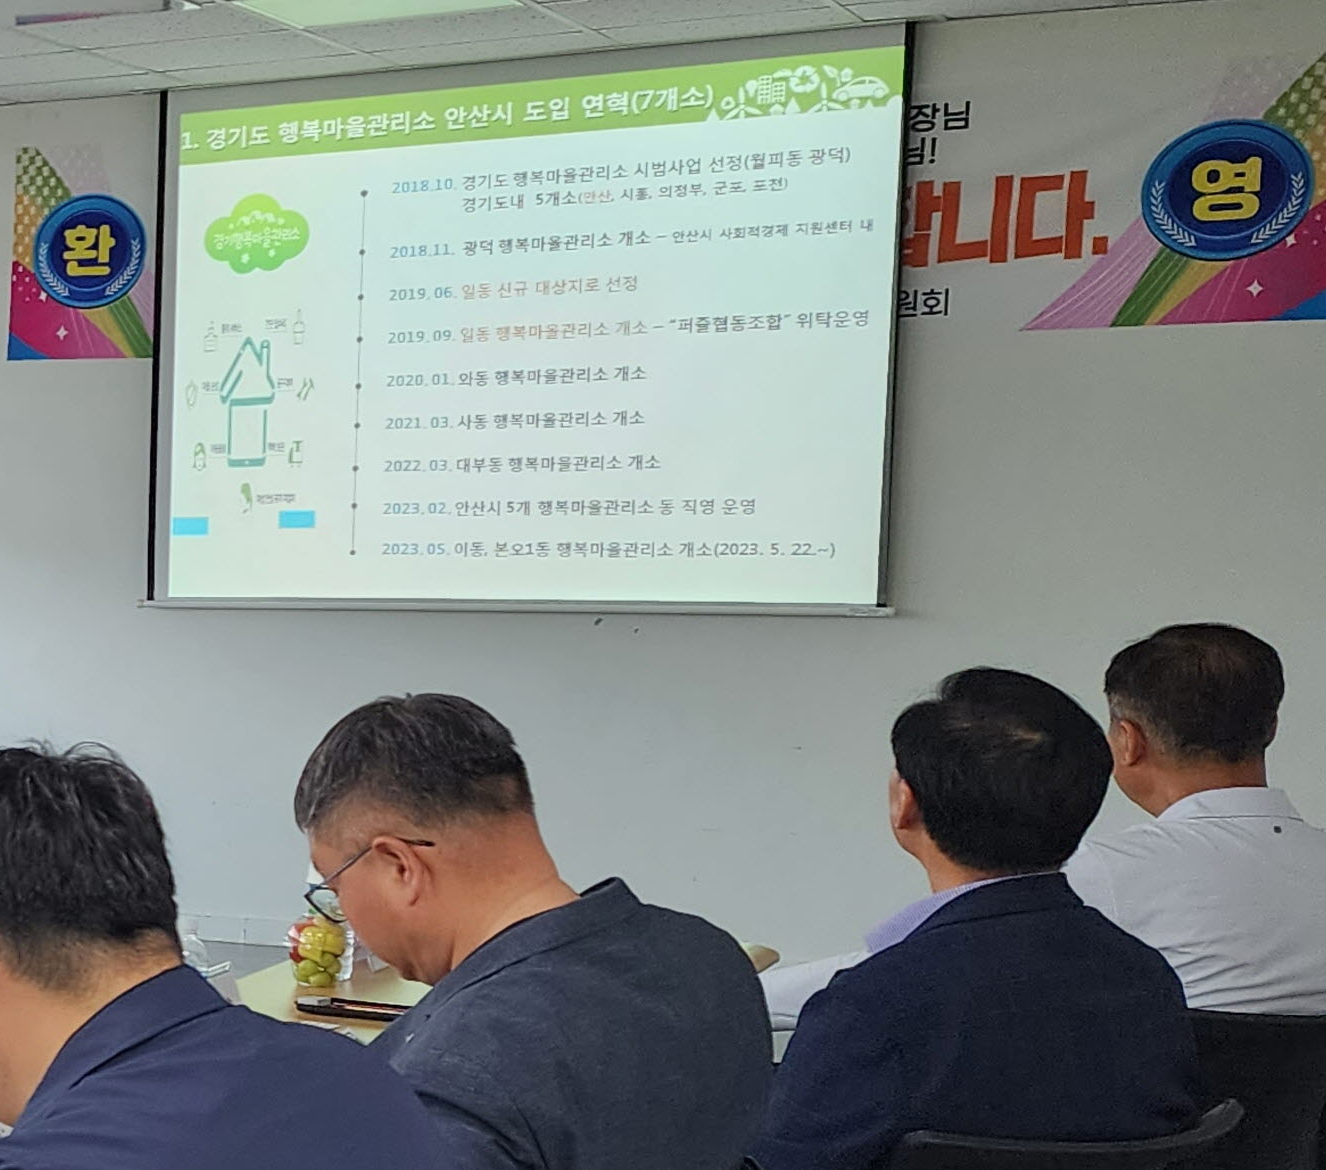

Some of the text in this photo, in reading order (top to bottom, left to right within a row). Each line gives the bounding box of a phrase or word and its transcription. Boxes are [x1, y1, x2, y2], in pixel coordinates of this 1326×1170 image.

[181, 84, 714, 151] 1. 경기도 행복마을관리소 안산시 도입 연혁(7개소)
[461, 174, 509, 191] 경기도
[513, 164, 628, 187] 행복마을관리소
[634, 158, 701, 178] 시범사업
[1191, 157, 1263, 222] 영
[462, 194, 524, 213] 경기도내
[63, 225, 116, 276] 환
[462, 239, 494, 257] 광덕
[498, 232, 613, 255] 행복마을관리소
[617, 229, 650, 246] 개소
[672, 228, 712, 244] 안산시
[720, 223, 789, 240] 사회적경제
[795, 219, 853, 236] 지원센터
[860, 218, 874, 232] 내
[461, 283, 492, 301] 일동
[497, 281, 529, 299] 신규
[535, 277, 600, 297] 대상지로
[605, 275, 638, 293] 선정
[460, 326, 491, 344] 일동
[495, 321, 610, 342] 행복마을관리소
[616, 320, 648, 337] 개소
[795, 310, 870, 330] 위탁운영
[458, 370, 490, 388] 와동
[495, 365, 609, 386] 행복마을관리소
[614, 366, 647, 382] 개소
[457, 414, 487, 430] 사동
[493, 411, 608, 429] 행복마을관리소
[612, 410, 646, 426] 개소
[456, 457, 503, 473] 대부동
[508, 455, 624, 472] 행복마을관리소
[628, 454, 661, 470] 개소
[455, 500, 501, 517] 안산시
[506, 499, 531, 516] 5개
[537, 499, 654, 516] 행복마을관리소
[658, 499, 674, 515] 동
[682, 498, 715, 515] 직영
[721, 498, 756, 515] 운영
[494, 541, 551, 558] 본오1동
[557, 541, 673, 558] 행복마을관리소
